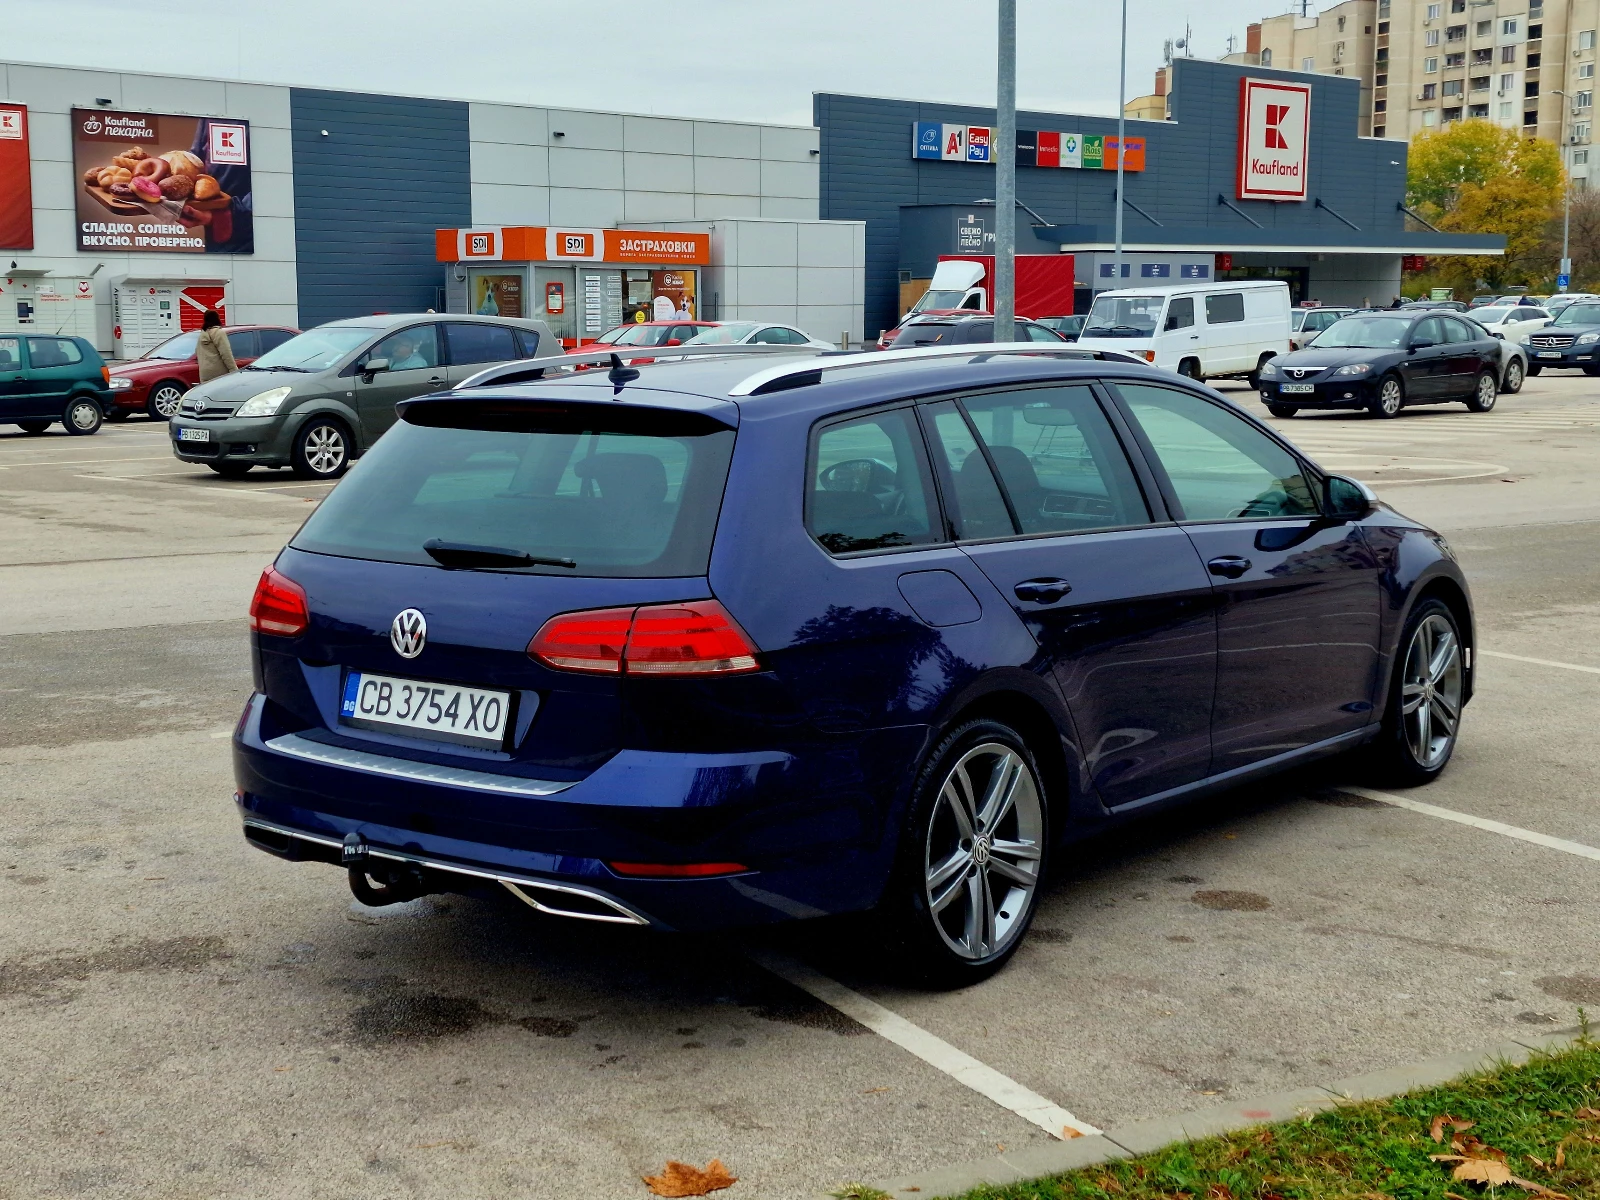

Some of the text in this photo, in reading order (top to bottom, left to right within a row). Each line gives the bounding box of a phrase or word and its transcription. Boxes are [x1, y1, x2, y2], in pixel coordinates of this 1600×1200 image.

[105, 116, 146, 127] Kaufland
[105, 126, 153, 139] пекарна
[946, 130, 963, 154] A1
[969, 133, 988, 146] Easy
[969, 145, 984, 158] Pay
[1252, 158, 1299, 176] Kaufland
[82, 222, 188, 235] СЛАДКО. СОЛЕНО.
[960, 227, 982, 235] СВЕЖО
[82, 235, 206, 248] ВКУСНО. ПРОВЕРЕНО.
[474, 238, 487, 249] SDI
[566, 238, 584, 249] SDI
[620, 239, 696, 253] ЗАСТРАХОВКИ
[343, 700, 355, 712] BG
[360, 680, 501, 733] CB 3754 XO
